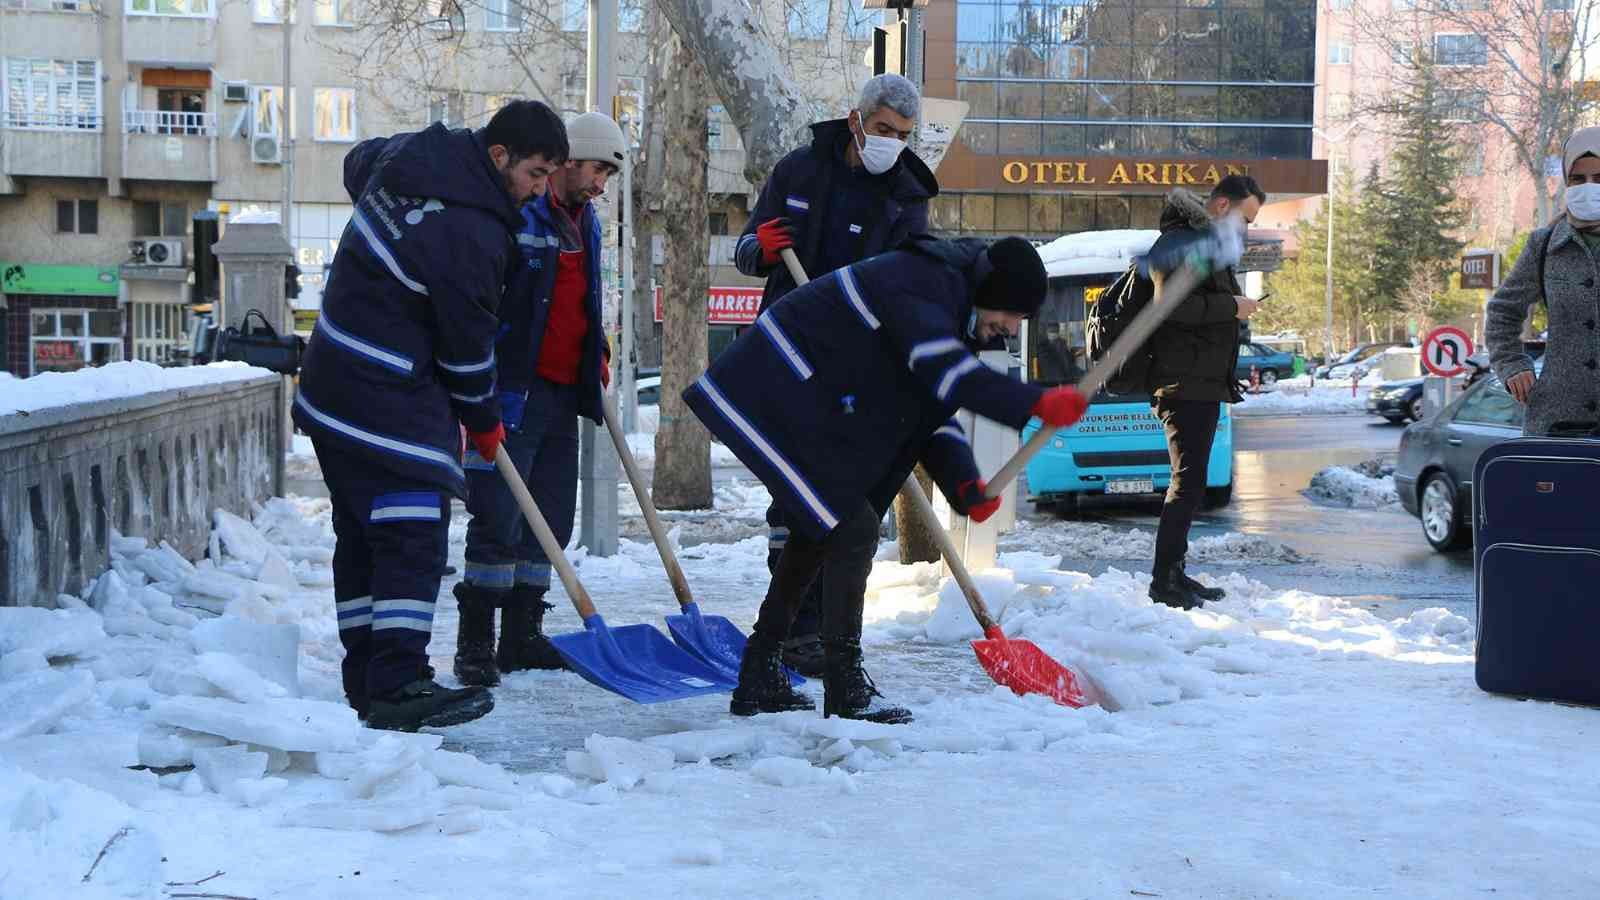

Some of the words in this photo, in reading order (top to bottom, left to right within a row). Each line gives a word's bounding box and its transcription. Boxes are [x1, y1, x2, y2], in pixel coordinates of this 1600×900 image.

[1003, 161, 1097, 185] OTEL
[1109, 161, 1249, 186] ARIKAN
[1463, 258, 1487, 274] OTEL
